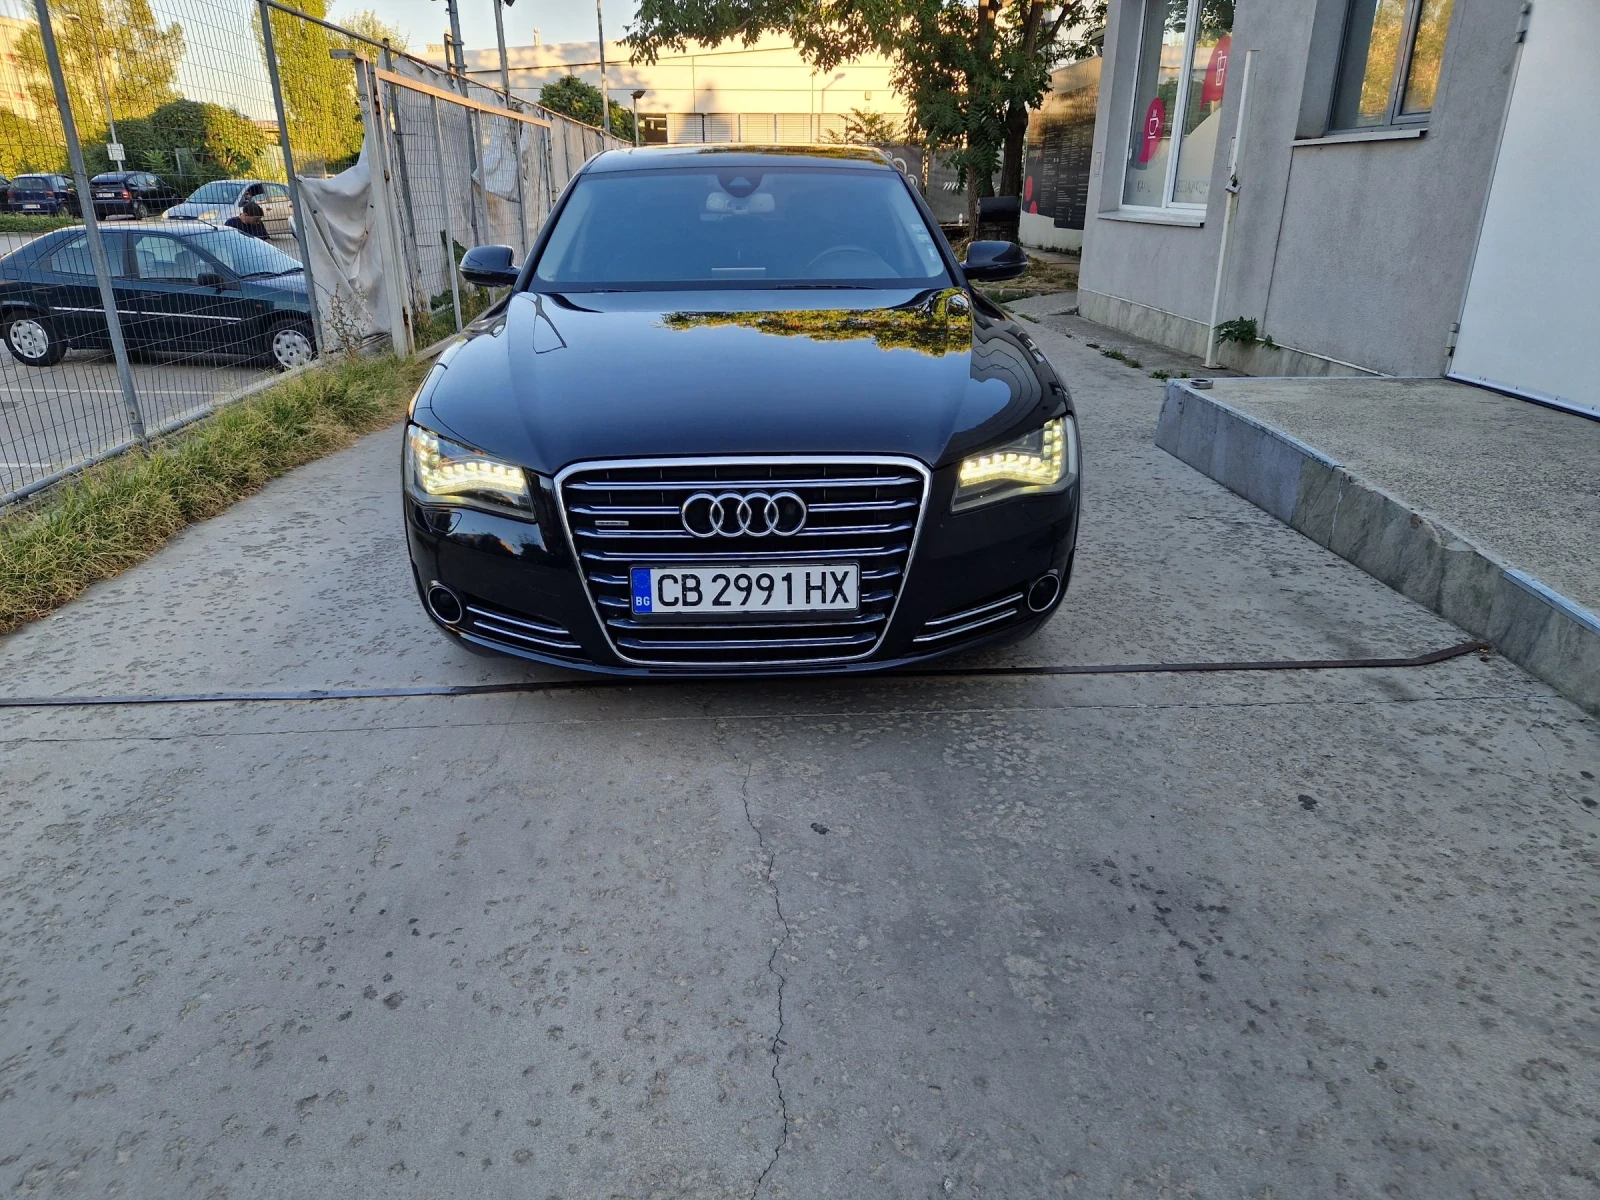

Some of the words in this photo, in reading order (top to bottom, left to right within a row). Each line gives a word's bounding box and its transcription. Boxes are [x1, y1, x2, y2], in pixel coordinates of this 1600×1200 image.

[657, 573, 703, 607] CB
[711, 572, 793, 607] 2991
[805, 571, 850, 604] HX
[635, 596, 650, 606] BG
